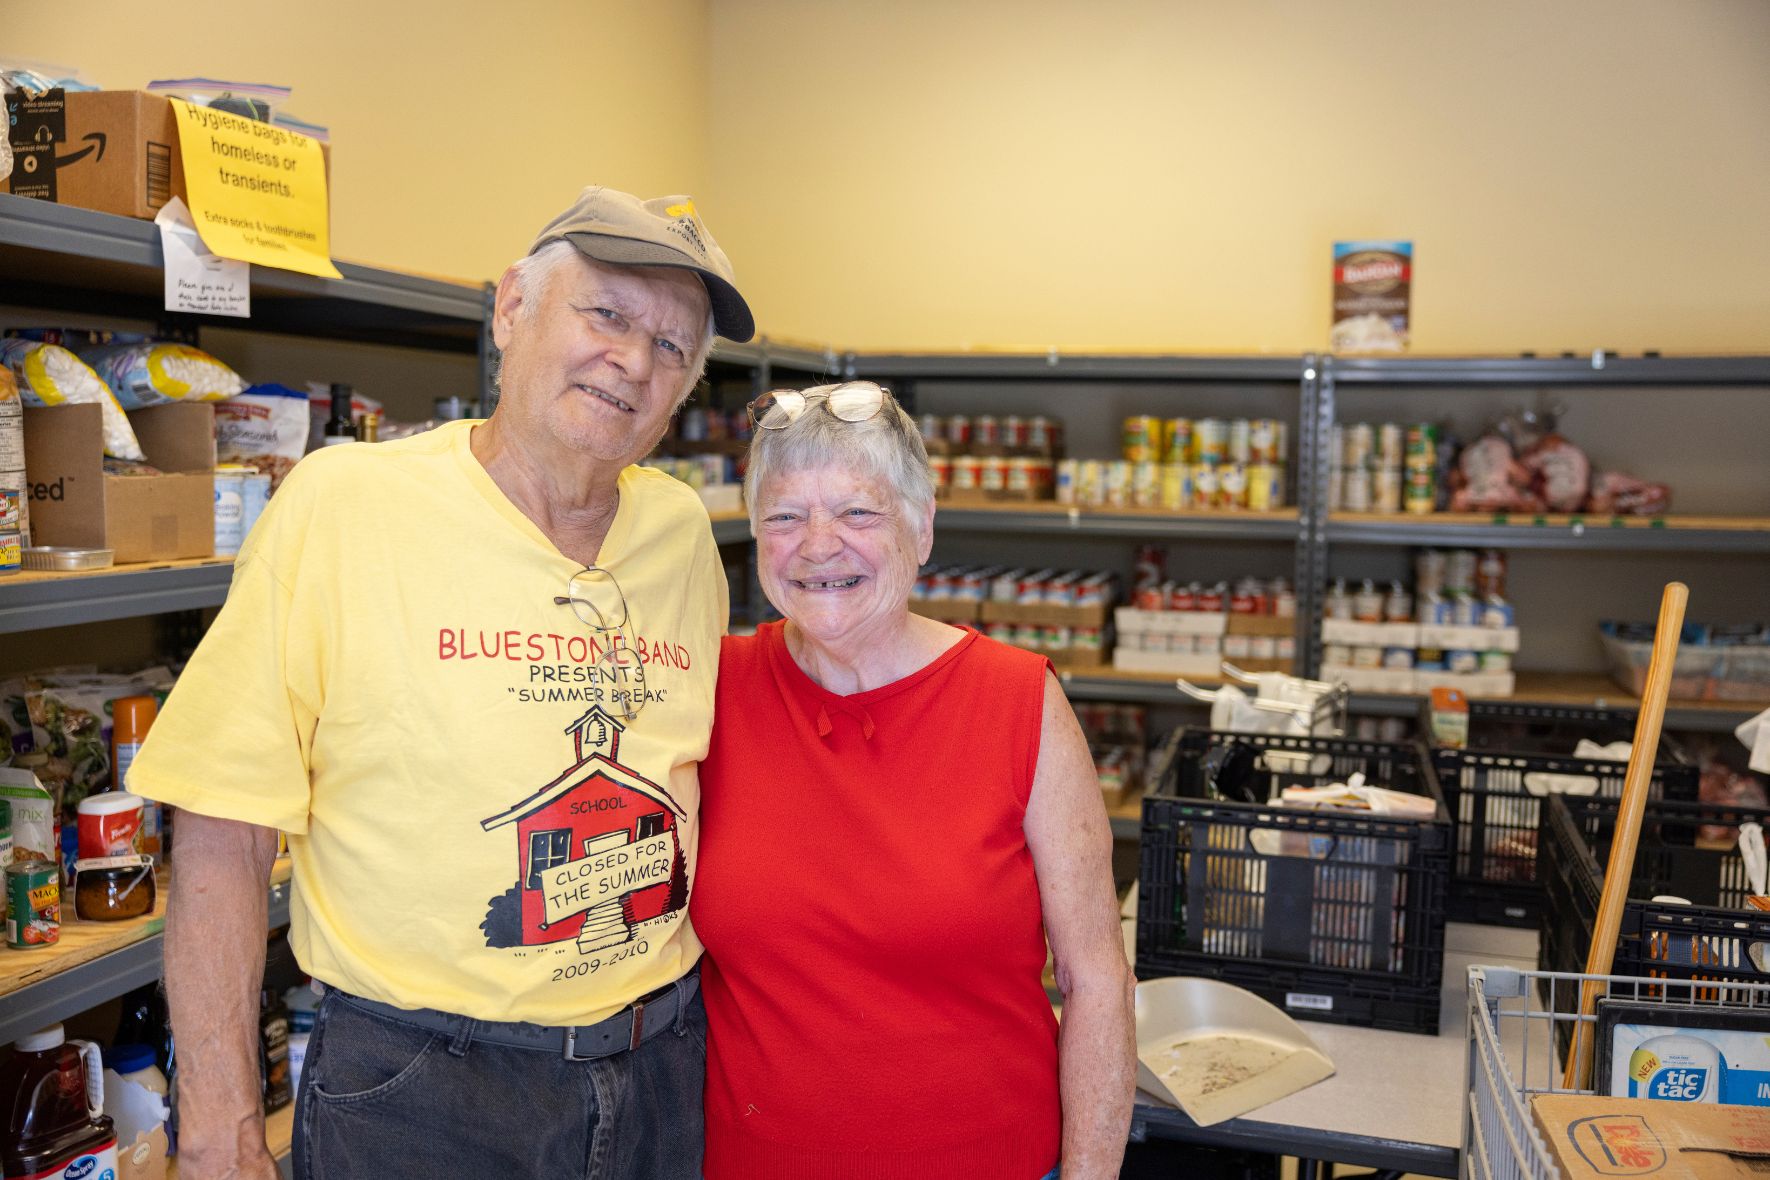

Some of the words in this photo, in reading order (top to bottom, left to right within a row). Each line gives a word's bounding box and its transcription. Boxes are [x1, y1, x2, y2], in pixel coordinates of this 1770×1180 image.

[185, 102, 250, 134] Hygiene
[251, 119, 287, 146] bags
[288, 130, 308, 148] for
[210, 136, 280, 168] homeless
[283, 158, 297, 172] or
[219, 167, 295, 198] transients.
[204, 211, 229, 226] Extra
[230, 218, 255, 231] socks
[264, 223, 316, 241] toothbrushes
[243, 234, 255, 245] for
[439, 628, 629, 664] BLUESTONE
[638, 636, 691, 671] BAND
[529, 664, 645, 684] PRESENTS
[508, 687, 604, 703] "SUMMER
[610, 687, 668, 703] BREAK"
[18, 807, 44, 820] mix
[570, 797, 628, 815] SCHOOL
[555, 852, 629, 886] CLOSED
[635, 840, 667, 862] FOR
[549, 886, 591, 909] THE
[599, 859, 670, 895] SUMMER
[551, 940, 650, 982] 2009-2010
[1637, 1057, 1658, 1080] NEW
[1667, 1070, 1699, 1087] tic
[1657, 1082, 1697, 1099] tac
[65, 1168, 81, 1178] Ocean
[79, 1159, 94, 1175] Spray
